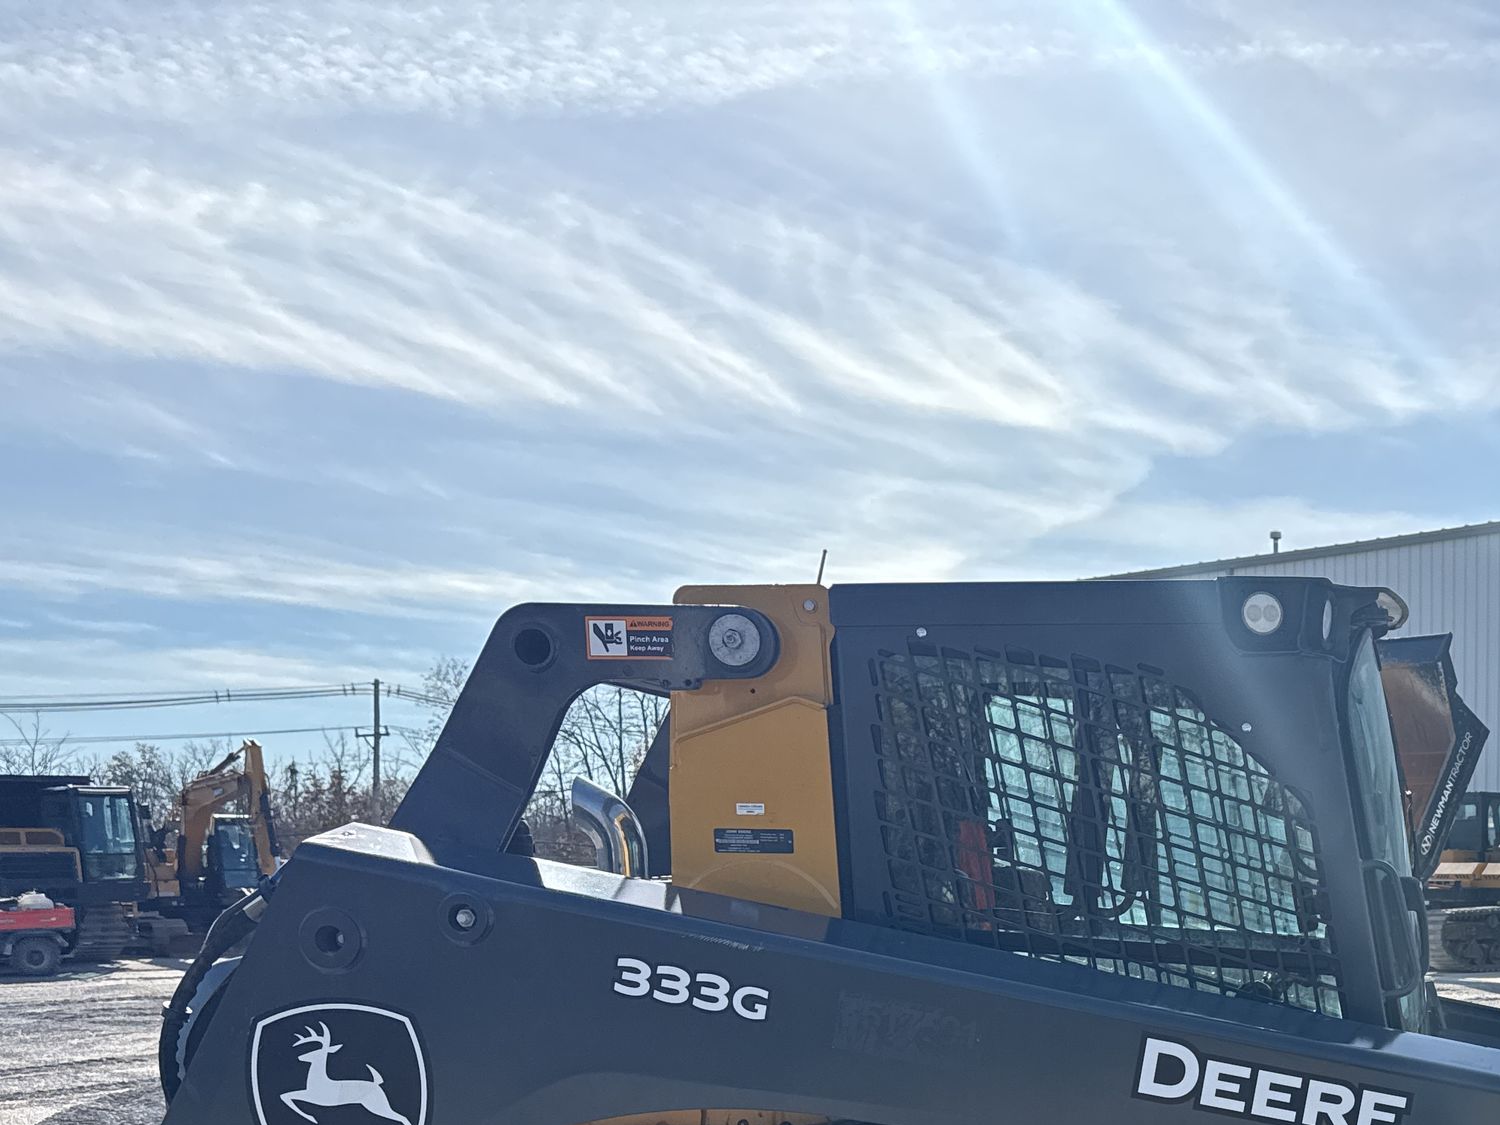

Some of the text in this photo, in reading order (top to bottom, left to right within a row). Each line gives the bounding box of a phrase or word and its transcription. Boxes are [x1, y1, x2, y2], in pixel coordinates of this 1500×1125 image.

[637, 620, 670, 628] WARNING
[629, 635, 669, 643] Pinch Area
[630, 644, 664, 652] Keep Away
[613, 957, 769, 1020] 333G
